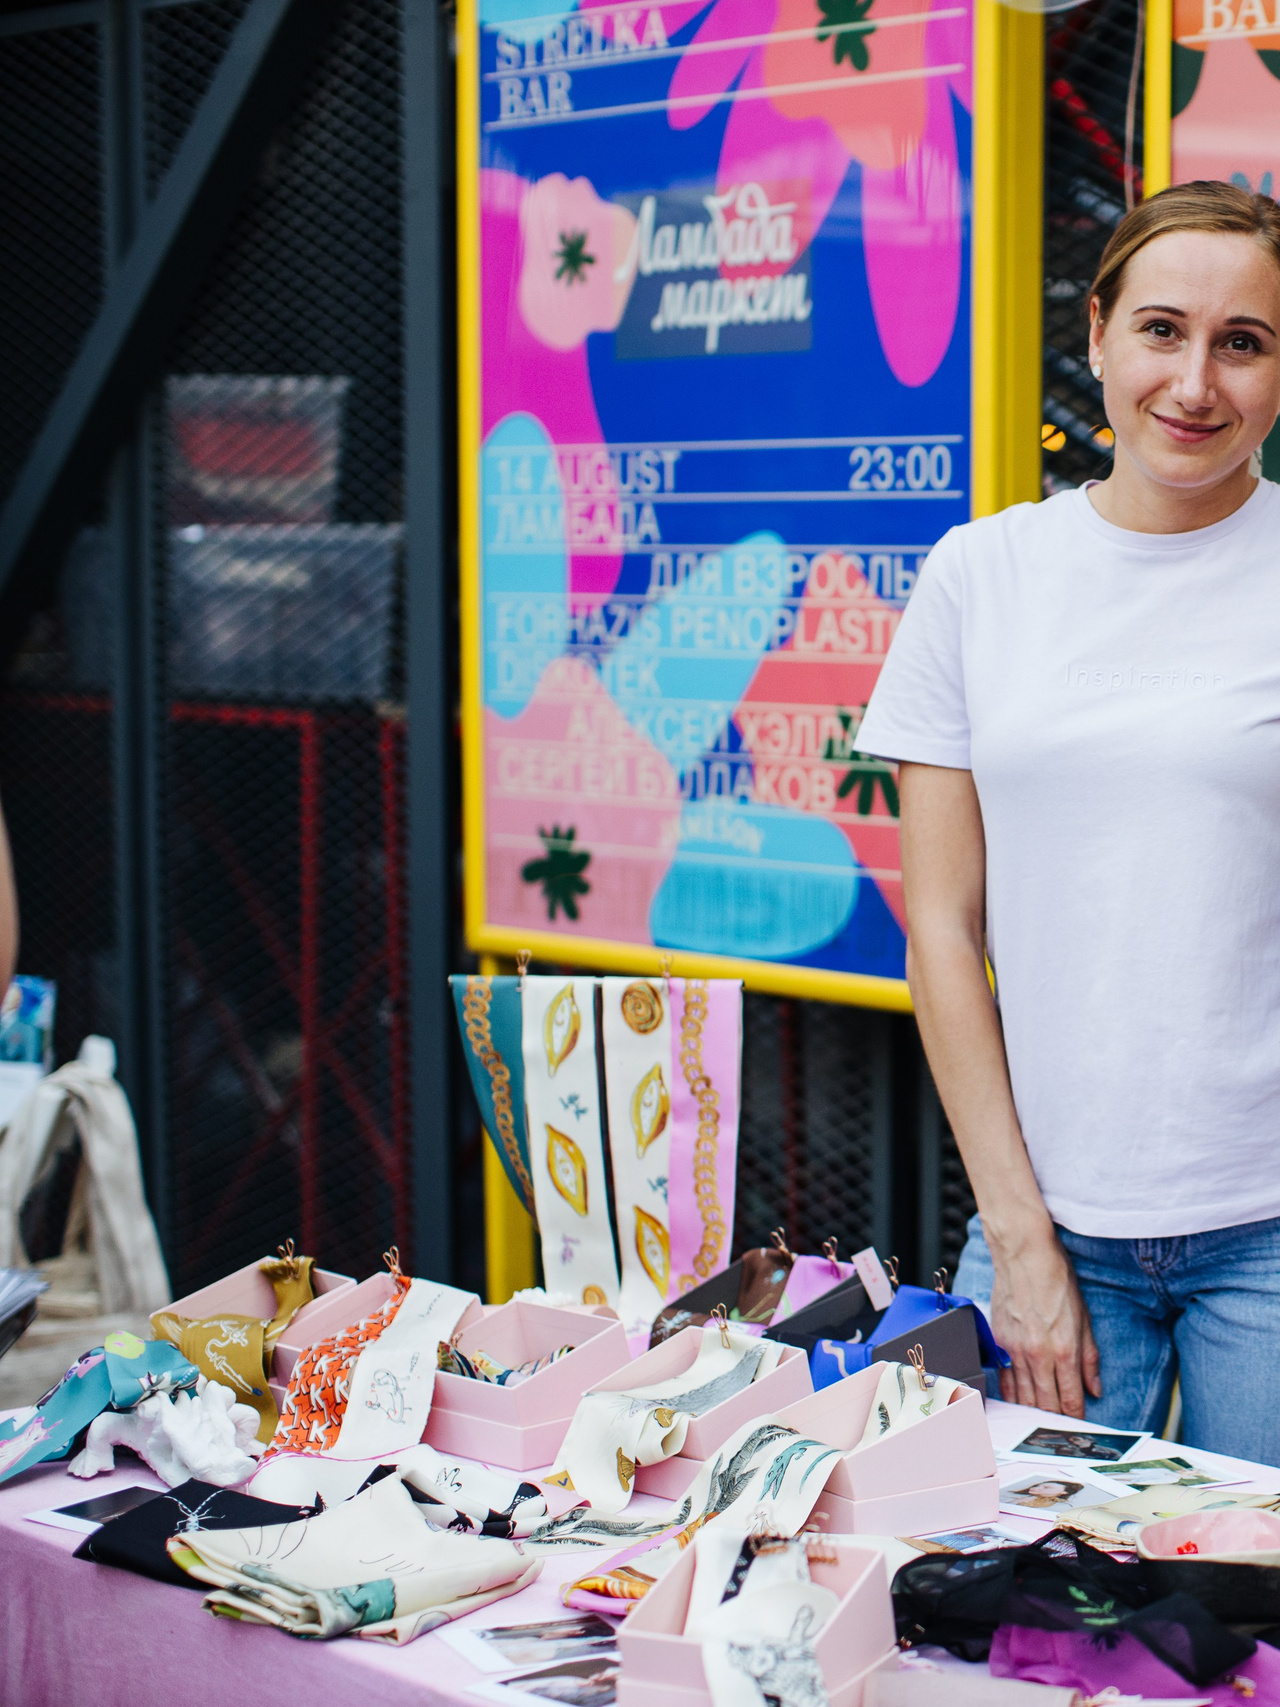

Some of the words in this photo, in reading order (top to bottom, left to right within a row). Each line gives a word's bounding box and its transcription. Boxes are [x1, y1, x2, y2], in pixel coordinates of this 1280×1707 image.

[495, 6, 671, 72] STRELKA
[498, 69, 573, 121] BAR
[613, 181, 800, 284] Ламбада
[651, 272, 813, 354] маркет
[499, 457, 533, 493] 14
[540, 449, 680, 494] AUGUST
[848, 444, 953, 491] 23:00
[493, 501, 663, 549] ЛАМБАДА
[1064, 662, 1226, 691] Inspiration
